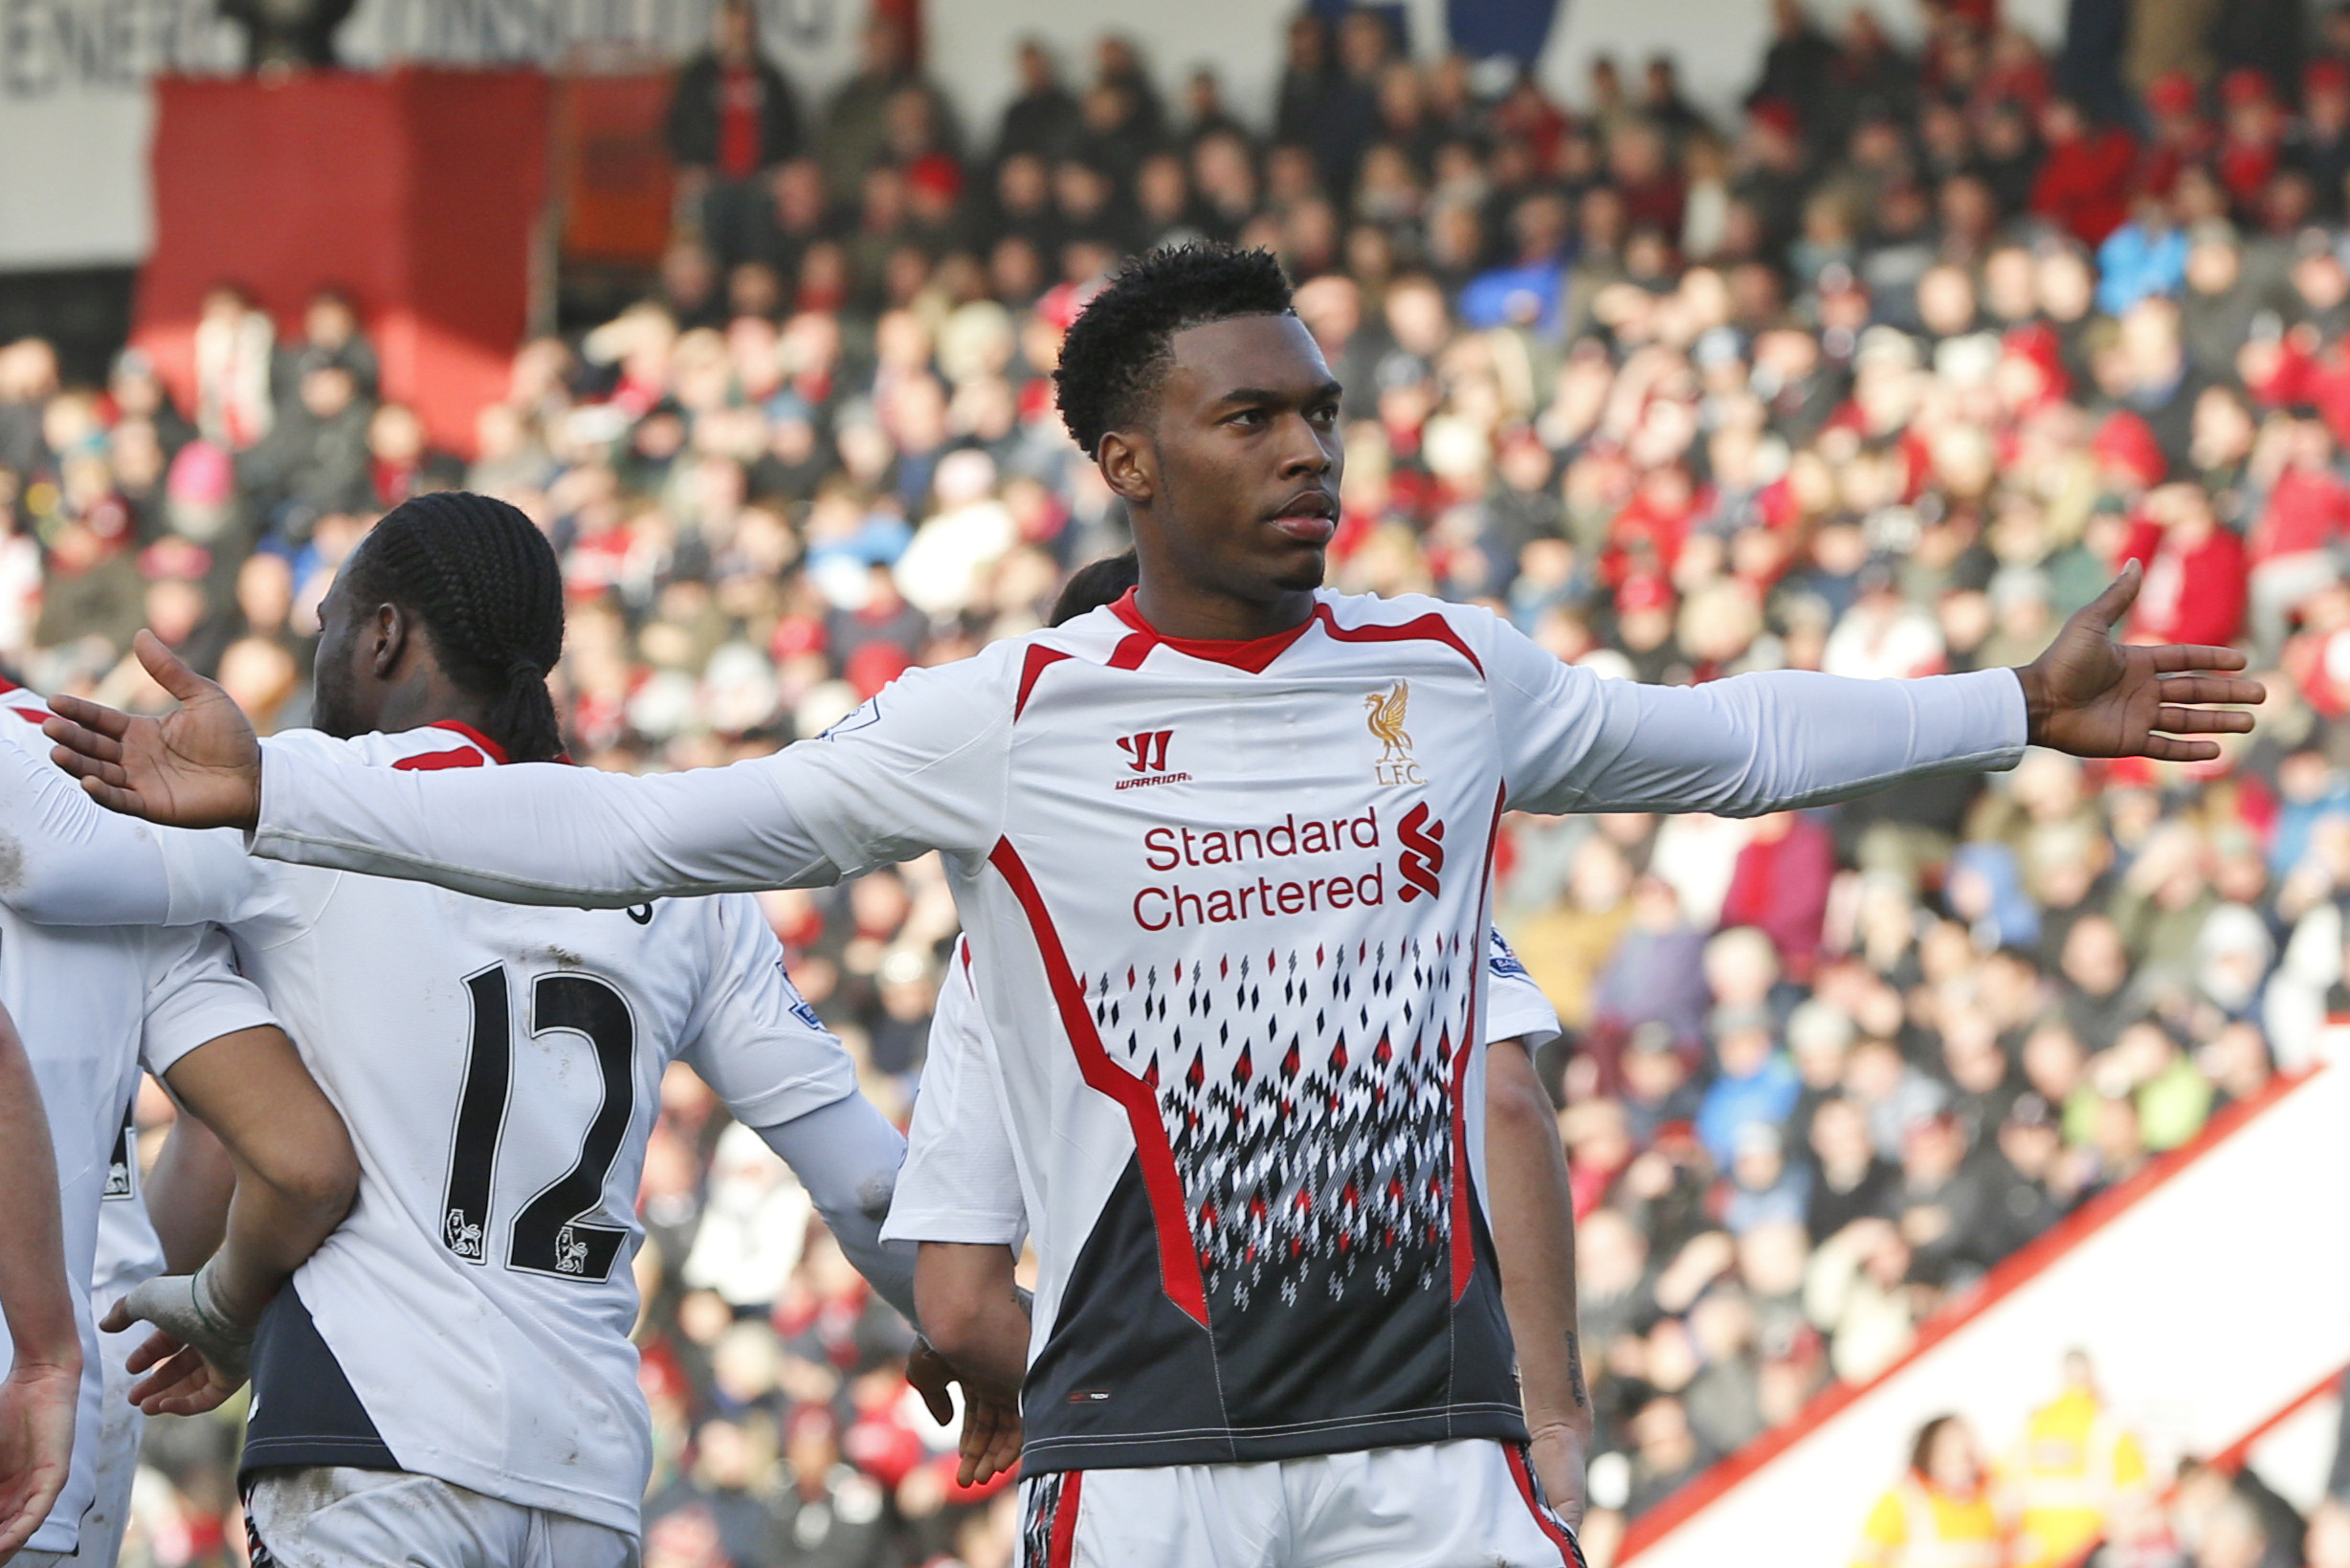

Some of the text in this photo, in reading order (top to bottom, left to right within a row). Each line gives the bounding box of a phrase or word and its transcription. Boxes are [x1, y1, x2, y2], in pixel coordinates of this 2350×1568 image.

[1115, 772, 1188, 790] WARRIOR
[1144, 806, 1380, 872] Standard
[1133, 863, 1385, 932] Chartered
[441, 960, 637, 1283] 12
